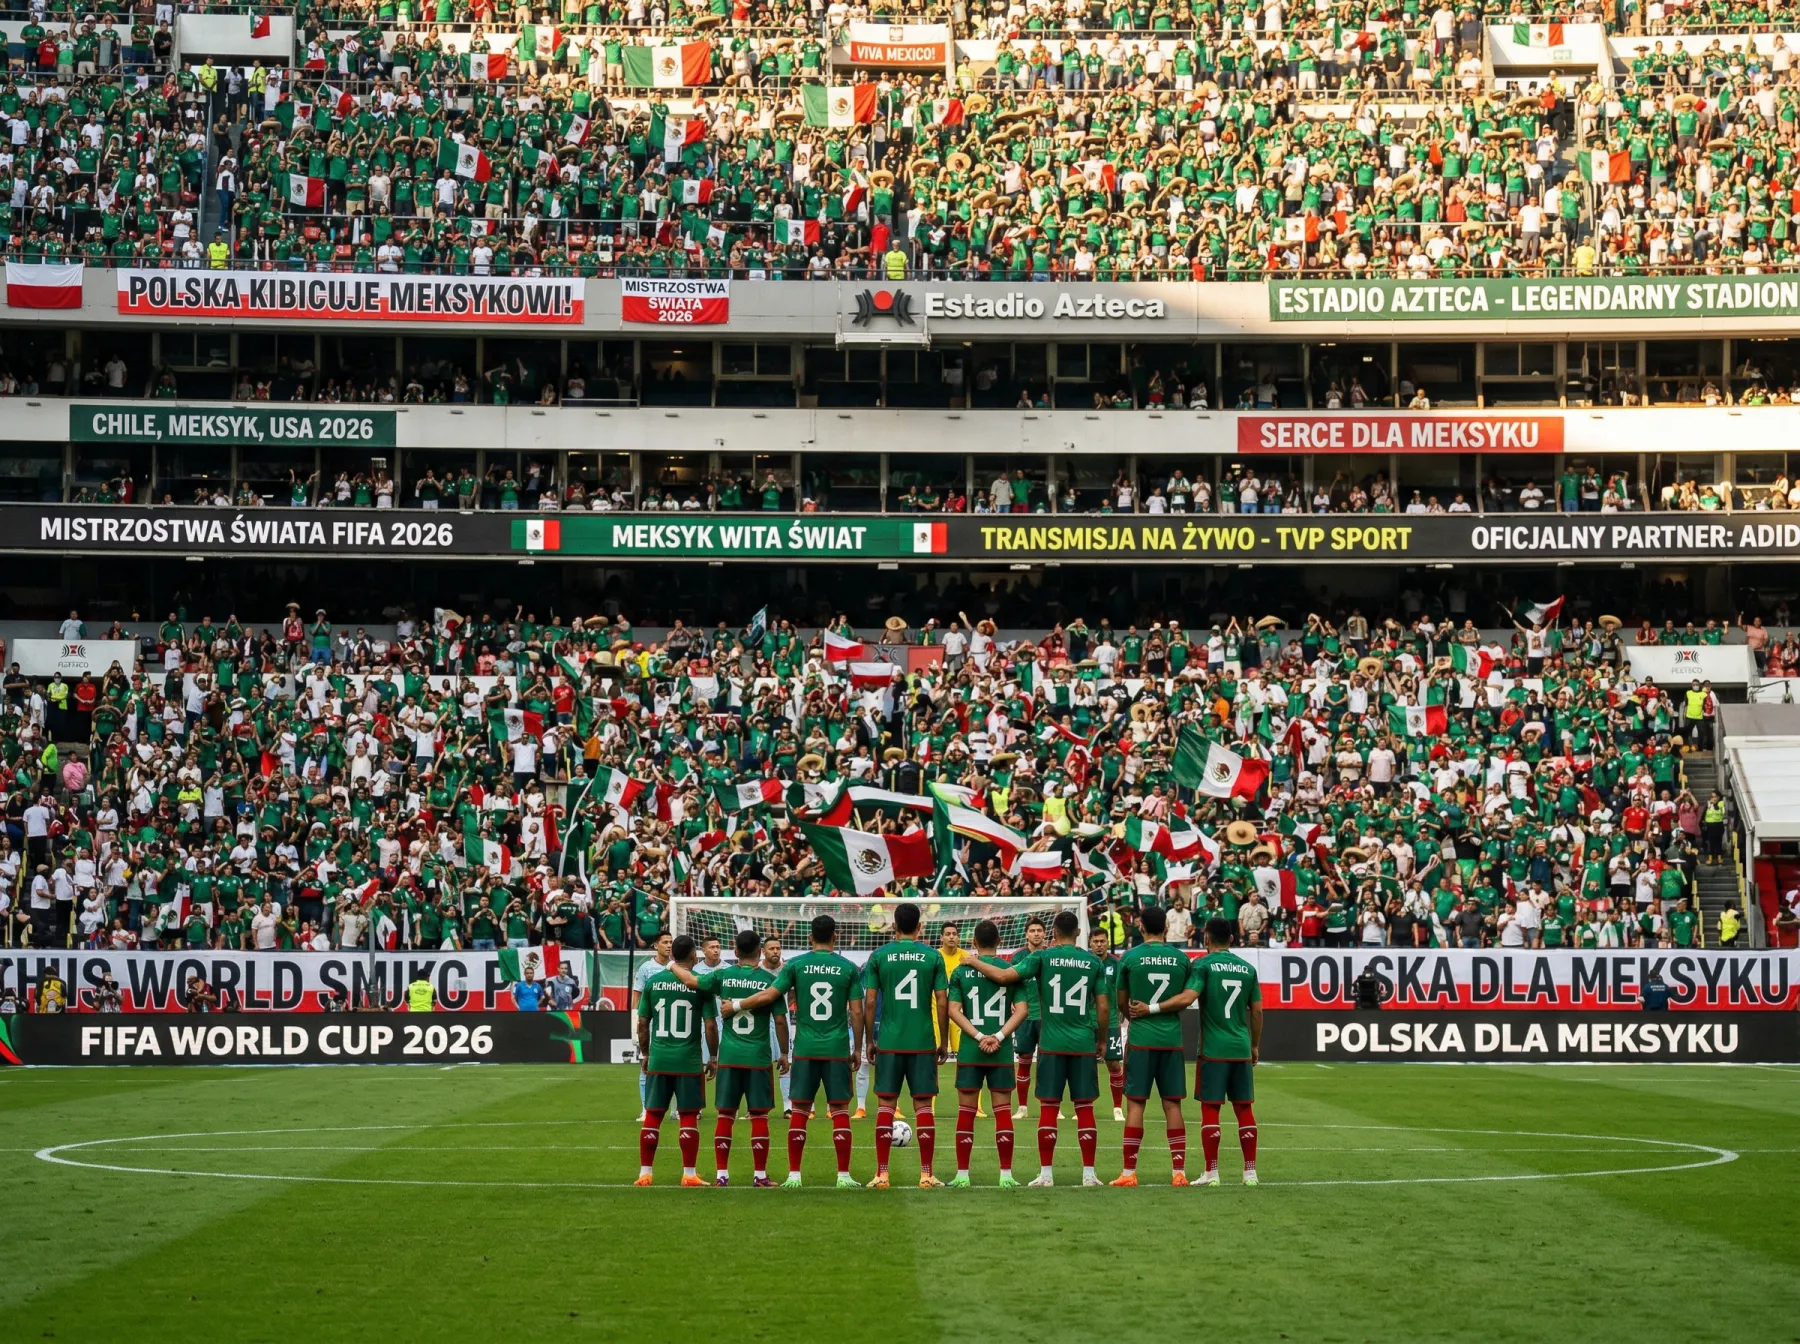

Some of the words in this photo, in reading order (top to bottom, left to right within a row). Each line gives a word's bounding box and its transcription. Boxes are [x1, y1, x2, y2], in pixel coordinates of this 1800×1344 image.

[856, 45, 884, 60] VIVA
[886, 46, 936, 62] MEXICO!
[128, 275, 242, 310] POLSKA
[249, 277, 380, 313] KIBICUJE
[388, 281, 575, 316] MEKSYKOWI!
[625, 280, 727, 294] MISTRZOSTWA
[1279, 286, 1385, 313] ESTADIO
[1391, 286, 1489, 312] AZTECA
[1511, 283, 1681, 312] LEGENDARNY
[1686, 281, 1799, 311] STADION
[658, 310, 694, 322] 2026
[924, 291, 1044, 319] Estadio
[1053, 291, 1166, 319] Azteca
[92, 413, 163, 441] CHILE,
[168, 414, 265, 443] MEKSYK,
[269, 416, 314, 440] USA
[318, 417, 374, 441] 2026
[1260, 421, 1345, 449] SERCE
[1352, 422, 1404, 448] DLA
[1411, 421, 1539, 448] MEKSYKU
[40, 517, 226, 543] MISTRZOSTWA
[230, 513, 327, 545] ŚWIATA
[332, 521, 386, 546] FIFA
[390, 522, 454, 547] 2026
[612, 524, 714, 549] MEKSYK
[719, 525, 783, 549] WITA
[788, 519, 867, 550] ŚWIAT
[981, 526, 1137, 551] TRANSMISJA
[1142, 527, 1177, 551] NA
[1181, 521, 1255, 551] ŻYWO
[1275, 527, 1325, 551] TVP
[1330, 526, 1413, 551] SPORT
[1471, 525, 1607, 550] OFICJALNY
[1611, 524, 1734, 549] PARTNER:
[1739, 524, 1800, 548] ADID
[126, 958, 304, 1009] WORLD
[803, 963, 842, 976] JIMÉNEZ
[1280, 954, 1460, 1004] POLSKA
[1471, 955, 1560, 1003] DLA
[1570, 956, 1790, 1005] MEKSYKU
[809, 981, 834, 1021] 8
[894, 969, 918, 1009] 4
[1048, 973, 1089, 1016] 14
[1147, 972, 1171, 1004] 7
[1221, 979, 1243, 1019] 7
[654, 998, 693, 1039] 10
[966, 985, 1007, 1026] 14
[82, 1026, 162, 1056] FIFA
[168, 1025, 309, 1056] WORLD
[317, 1025, 394, 1056] CUP
[402, 1024, 494, 1055] 2026
[1316, 1022, 1467, 1053] POLSKA
[1474, 1023, 1549, 1053] DLA
[1557, 1023, 1739, 1054] MEKSYKU
